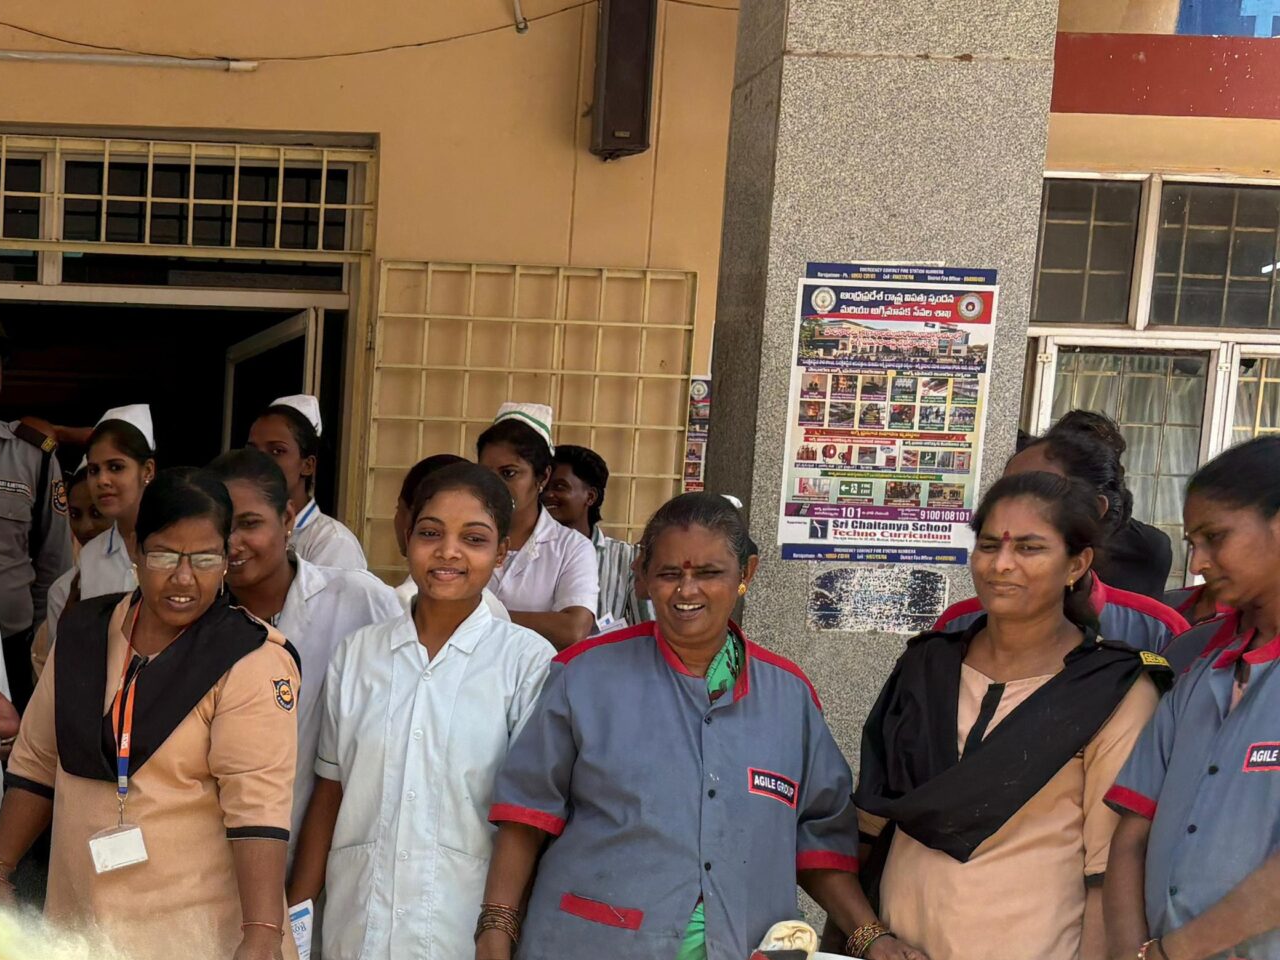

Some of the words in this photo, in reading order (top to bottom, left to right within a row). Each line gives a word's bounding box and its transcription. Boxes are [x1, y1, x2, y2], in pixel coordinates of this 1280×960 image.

[841, 506, 861, 518] 101
[920, 510, 970, 522] 9100108101
[832, 519, 849, 529] Sri
[850, 520, 909, 532] Chaitanya
[911, 522, 952, 533] School
[832, 529, 876, 538] Techno
[880, 531, 951, 540] Curriculum
[1250, 750, 1279, 762] AGILE
[754, 774, 776, 790] AGILE
